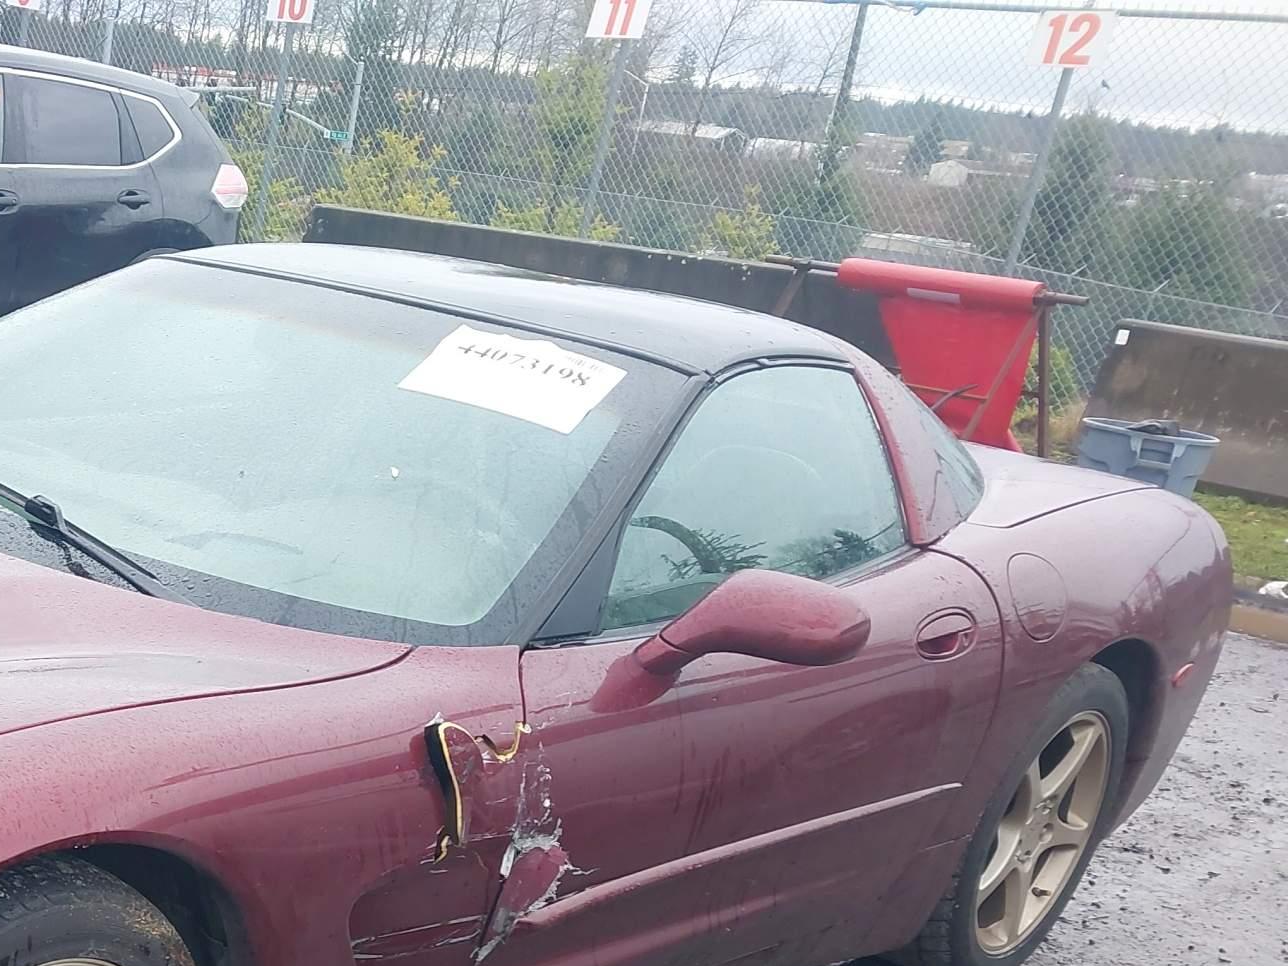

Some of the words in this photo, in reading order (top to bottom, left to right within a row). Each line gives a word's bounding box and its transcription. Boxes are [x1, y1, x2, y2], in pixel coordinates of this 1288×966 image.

[277, 0, 307, 20] 10
[604, 0, 636, 35] 11
[1042, 12, 1101, 65] 12
[458, 344, 591, 386] 44073198
